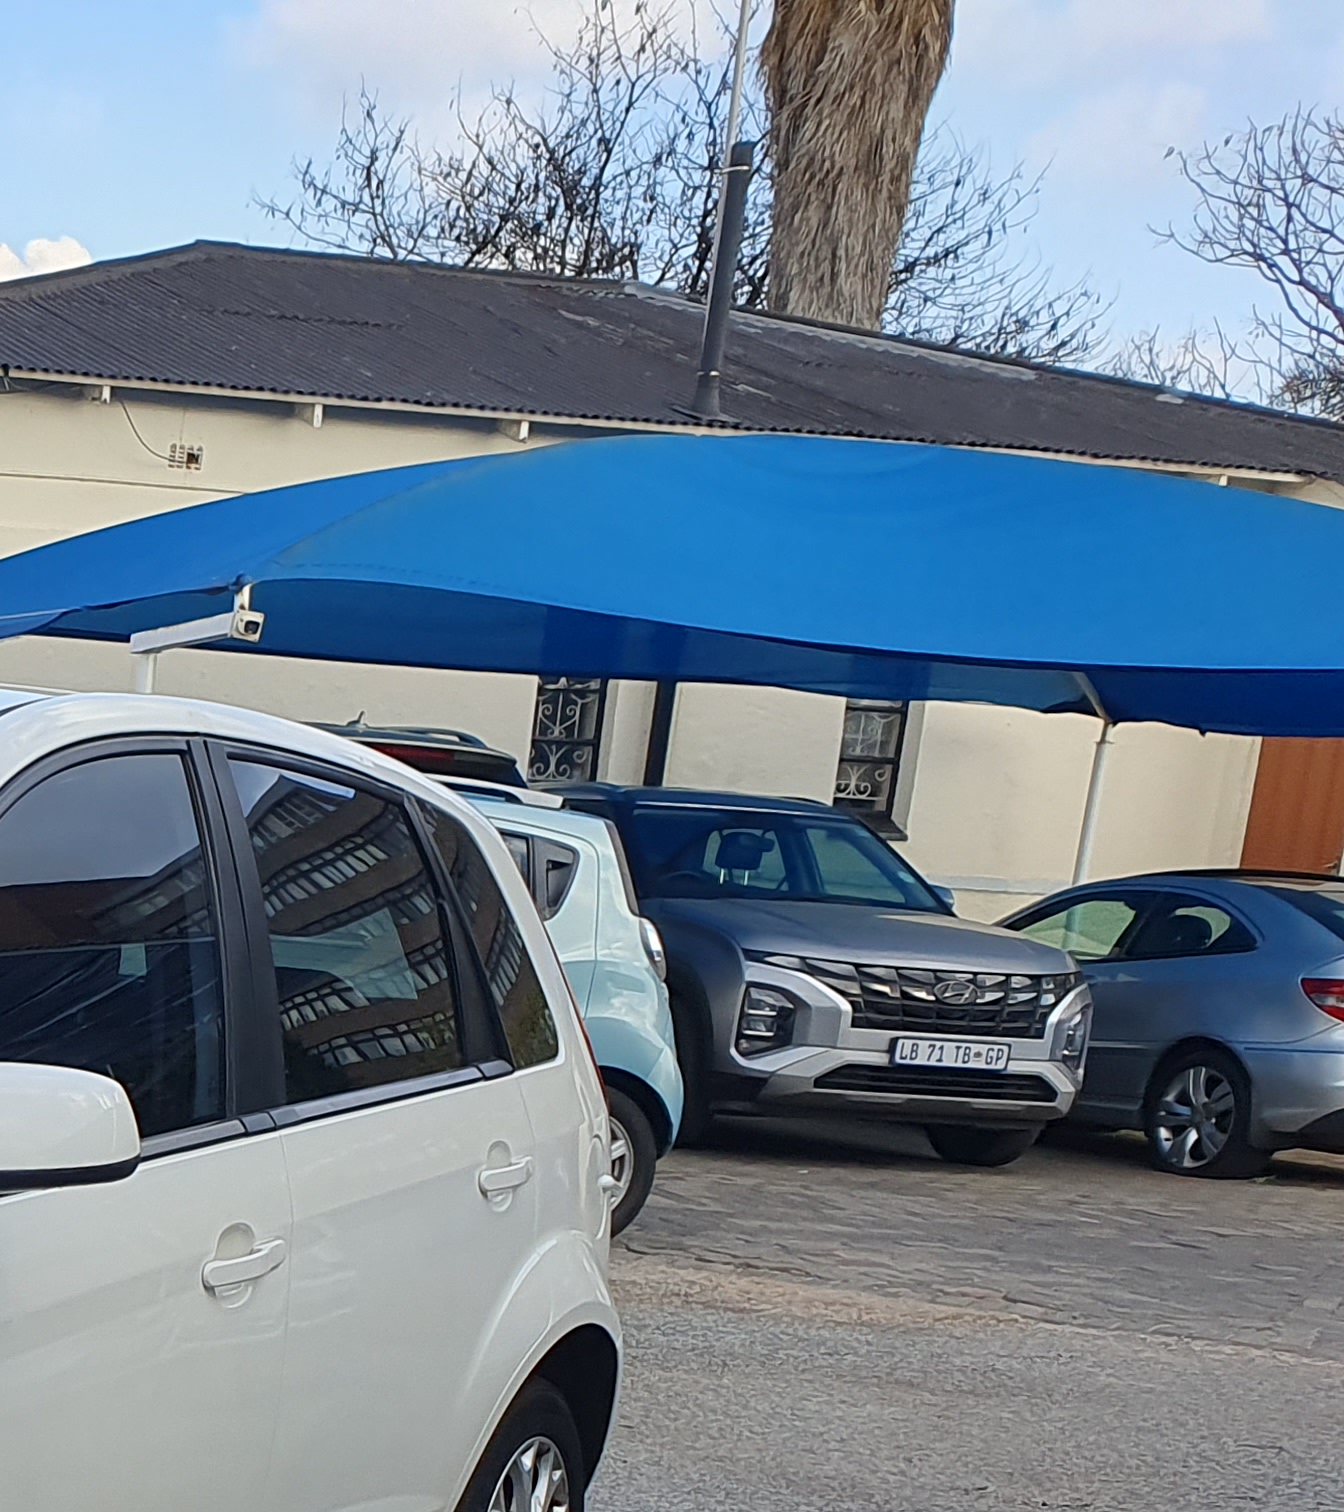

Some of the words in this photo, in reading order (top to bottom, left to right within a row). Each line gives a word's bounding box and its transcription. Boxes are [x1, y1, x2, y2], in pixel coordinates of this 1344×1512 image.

[899, 1042, 919, 1061] LB
[926, 1044, 944, 1062] 71
[954, 1045, 971, 1064] TB
[985, 1048, 1004, 1066] GP
